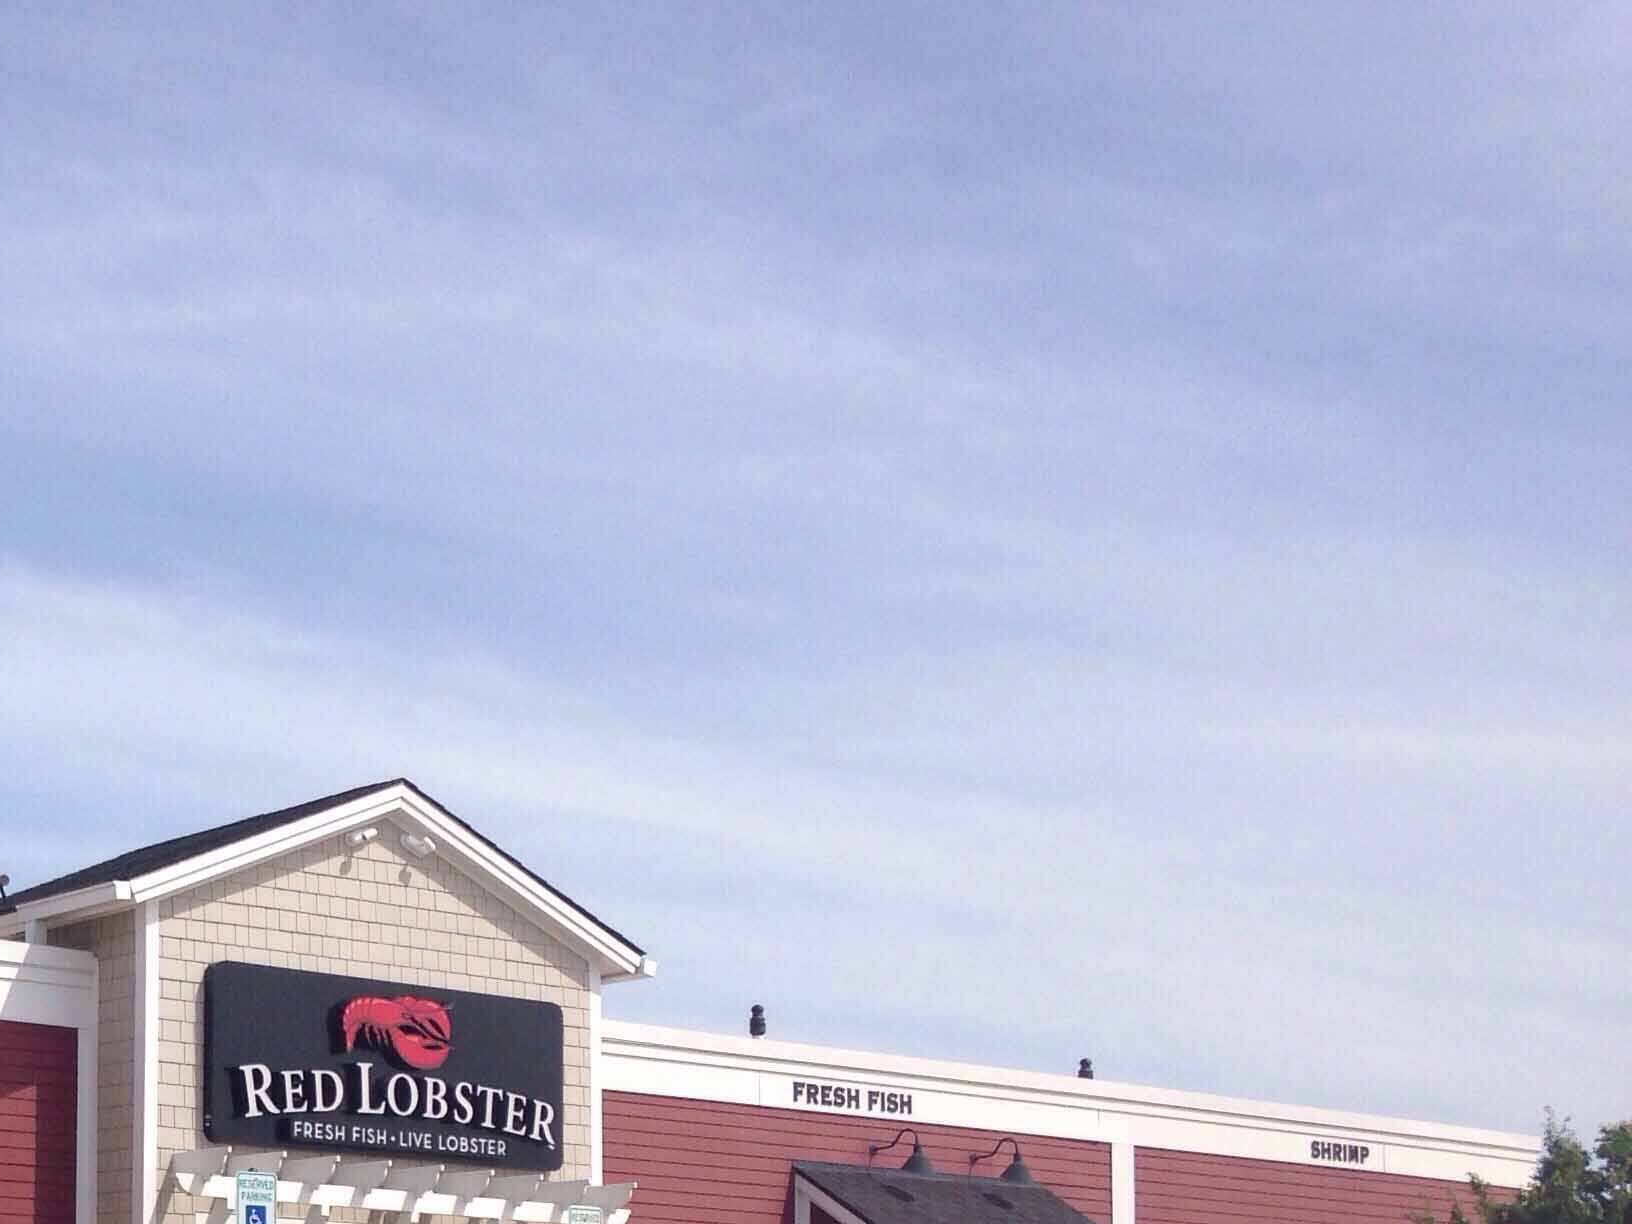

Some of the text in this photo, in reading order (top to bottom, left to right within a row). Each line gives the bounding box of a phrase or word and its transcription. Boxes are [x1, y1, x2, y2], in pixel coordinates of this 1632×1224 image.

[239, 1062, 556, 1145] RED LOBSTER
[793, 1081, 912, 1115] FRESH FISH
[294, 1121, 507, 1156] FRESH FISH LIVE LOBSTER
[1311, 1140, 1369, 1164] SHRIMP
